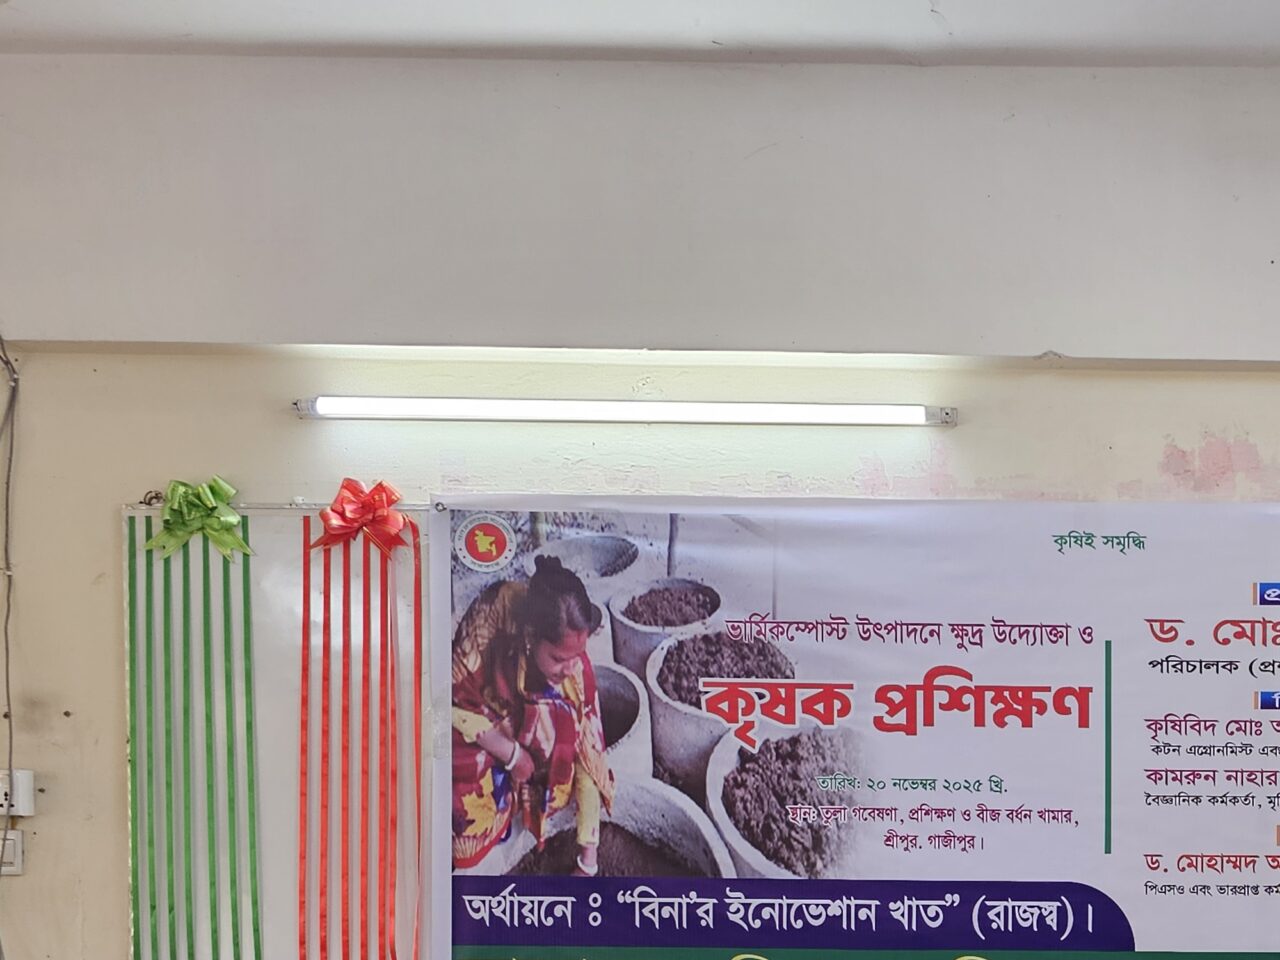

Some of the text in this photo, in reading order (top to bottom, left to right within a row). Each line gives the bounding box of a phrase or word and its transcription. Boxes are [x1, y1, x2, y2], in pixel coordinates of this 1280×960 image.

[1052, 530, 1147, 555] কৃষিই সমৃদ্ধি
[726, 612, 1094, 653] ভার্মিকম্পোস্ট উৎপাদনে ক্ষুদ্র উদ্যোক্তা ও
[1144, 618, 1195, 647] ড.
[1148, 655, 1240, 675] পরিচালক
[703, 665, 1093, 750] কৃষক প্রশিক্ষণ
[1144, 712, 1219, 741] কৃষিবিদ
[1225, 718, 1263, 737] মোঃ
[1151, 742, 1181, 757] কটন
[1186, 742, 1255, 757] এগ্রোনমিস্ট
[867, 778, 886, 792] ২০
[891, 778, 937, 791] নভেম্বর
[942, 778, 982, 793] ২০২৫
[1144, 768, 1280, 787] কামরুন নাহার
[1144, 791, 1203, 807] বৈজ্ঞানিক
[1207, 791, 1262, 809] কর্মকর্তা,
[820, 806, 848, 827] তুলা
[909, 803, 957, 823] প্রশিক্ষণ
[961, 809, 971, 821] ও
[975, 803, 1002, 823] বীজ
[1004, 803, 1033, 824] বর্ধন
[1037, 807, 1079, 828] খামার,
[1144, 854, 1169, 874] ড.
[1176, 853, 1259, 874] মোহাম্মদ
[1144, 880, 1185, 896] পিএসও
[1189, 883, 1212, 897] এবং
[1216, 883, 1260, 898] ভারপ্রাপ্ত
[462, 889, 573, 930] অর্থায়নে
[725, 888, 880, 932] ইনোভেশান
